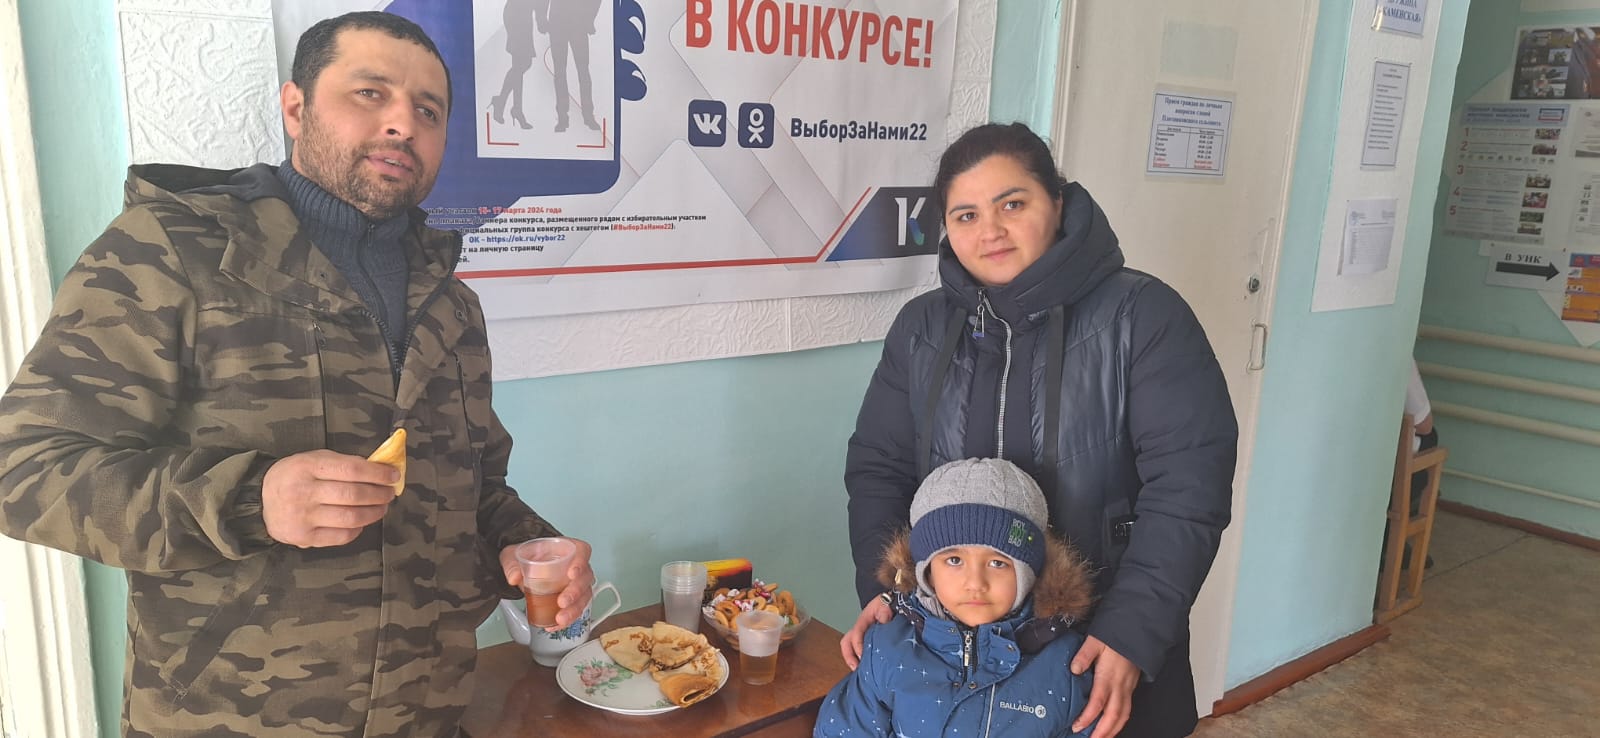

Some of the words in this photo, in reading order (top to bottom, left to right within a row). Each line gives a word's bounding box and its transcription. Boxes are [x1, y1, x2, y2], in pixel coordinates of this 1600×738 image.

[686, 0, 712, 48] В
[727, 0, 934, 68] КОНКУРСЕ!
[791, 118, 927, 142] ВыборЗаНами22
[502, 207, 525, 215] марта
[510, 226, 535, 234] группа
[486, 234, 565, 243] https://ok.ru/vybor22
[510, 245, 544, 253] страницу
[1505, 253, 1512, 261] В
[1012, 518, 1026, 531] BOY
[1008, 535, 1021, 547] BAD
[1000, 701, 1034, 714] BALLABIO
